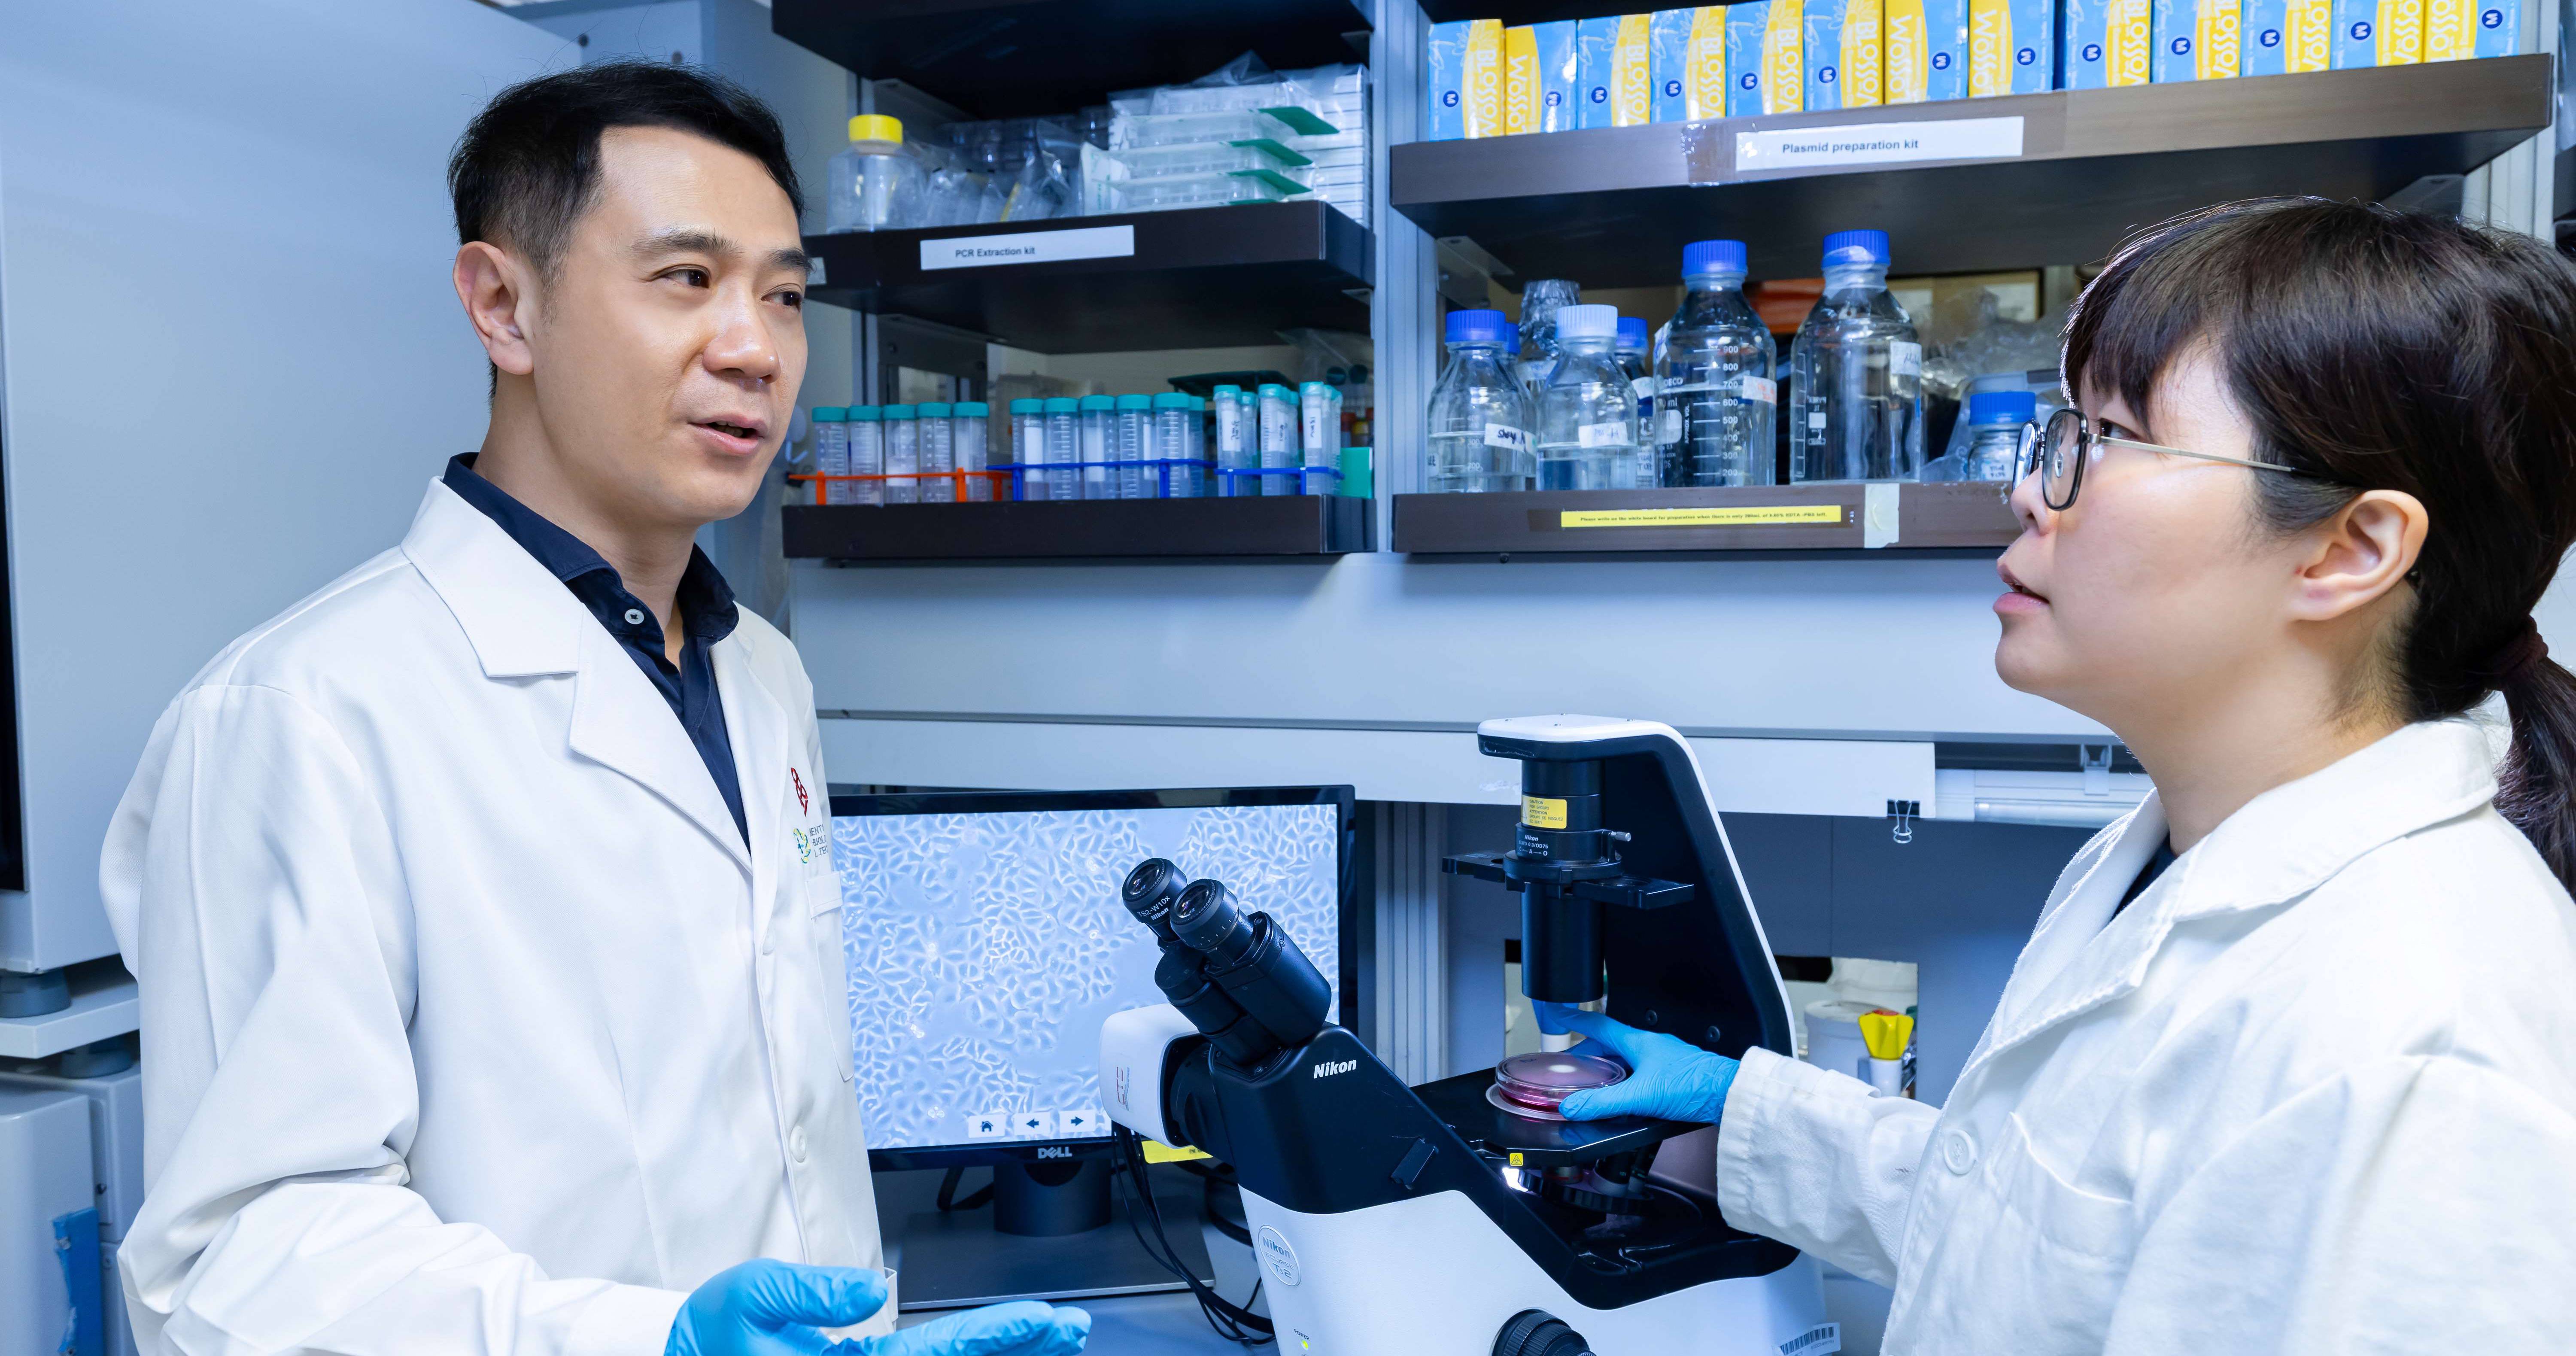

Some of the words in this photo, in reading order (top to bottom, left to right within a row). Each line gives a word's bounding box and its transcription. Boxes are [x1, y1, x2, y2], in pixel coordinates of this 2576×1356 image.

[1889, 15, 1912, 103] LOSSOM
[1508, 55, 1528, 136] LOSSOM
[1783, 142, 1828, 153] Plasmid
[1832, 140, 1900, 153] preparation
[1905, 139, 1918, 149] kit
[955, 249, 974, 258] PCR
[977, 247, 1022, 257] Extraction
[1024, 246, 1036, 254] kit
[1137, 896, 1170, 917] TS2-W10x
[1151, 907, 1169, 920] Nikon
[1314, 1059, 1357, 1079] Nikon
[1038, 1146, 1072, 1159] DELL
[1262, 1236, 1290, 1258] Nikon
[1265, 1251, 1295, 1270] ECLIPSE
[1294, 1329, 1310, 1341] POWER
